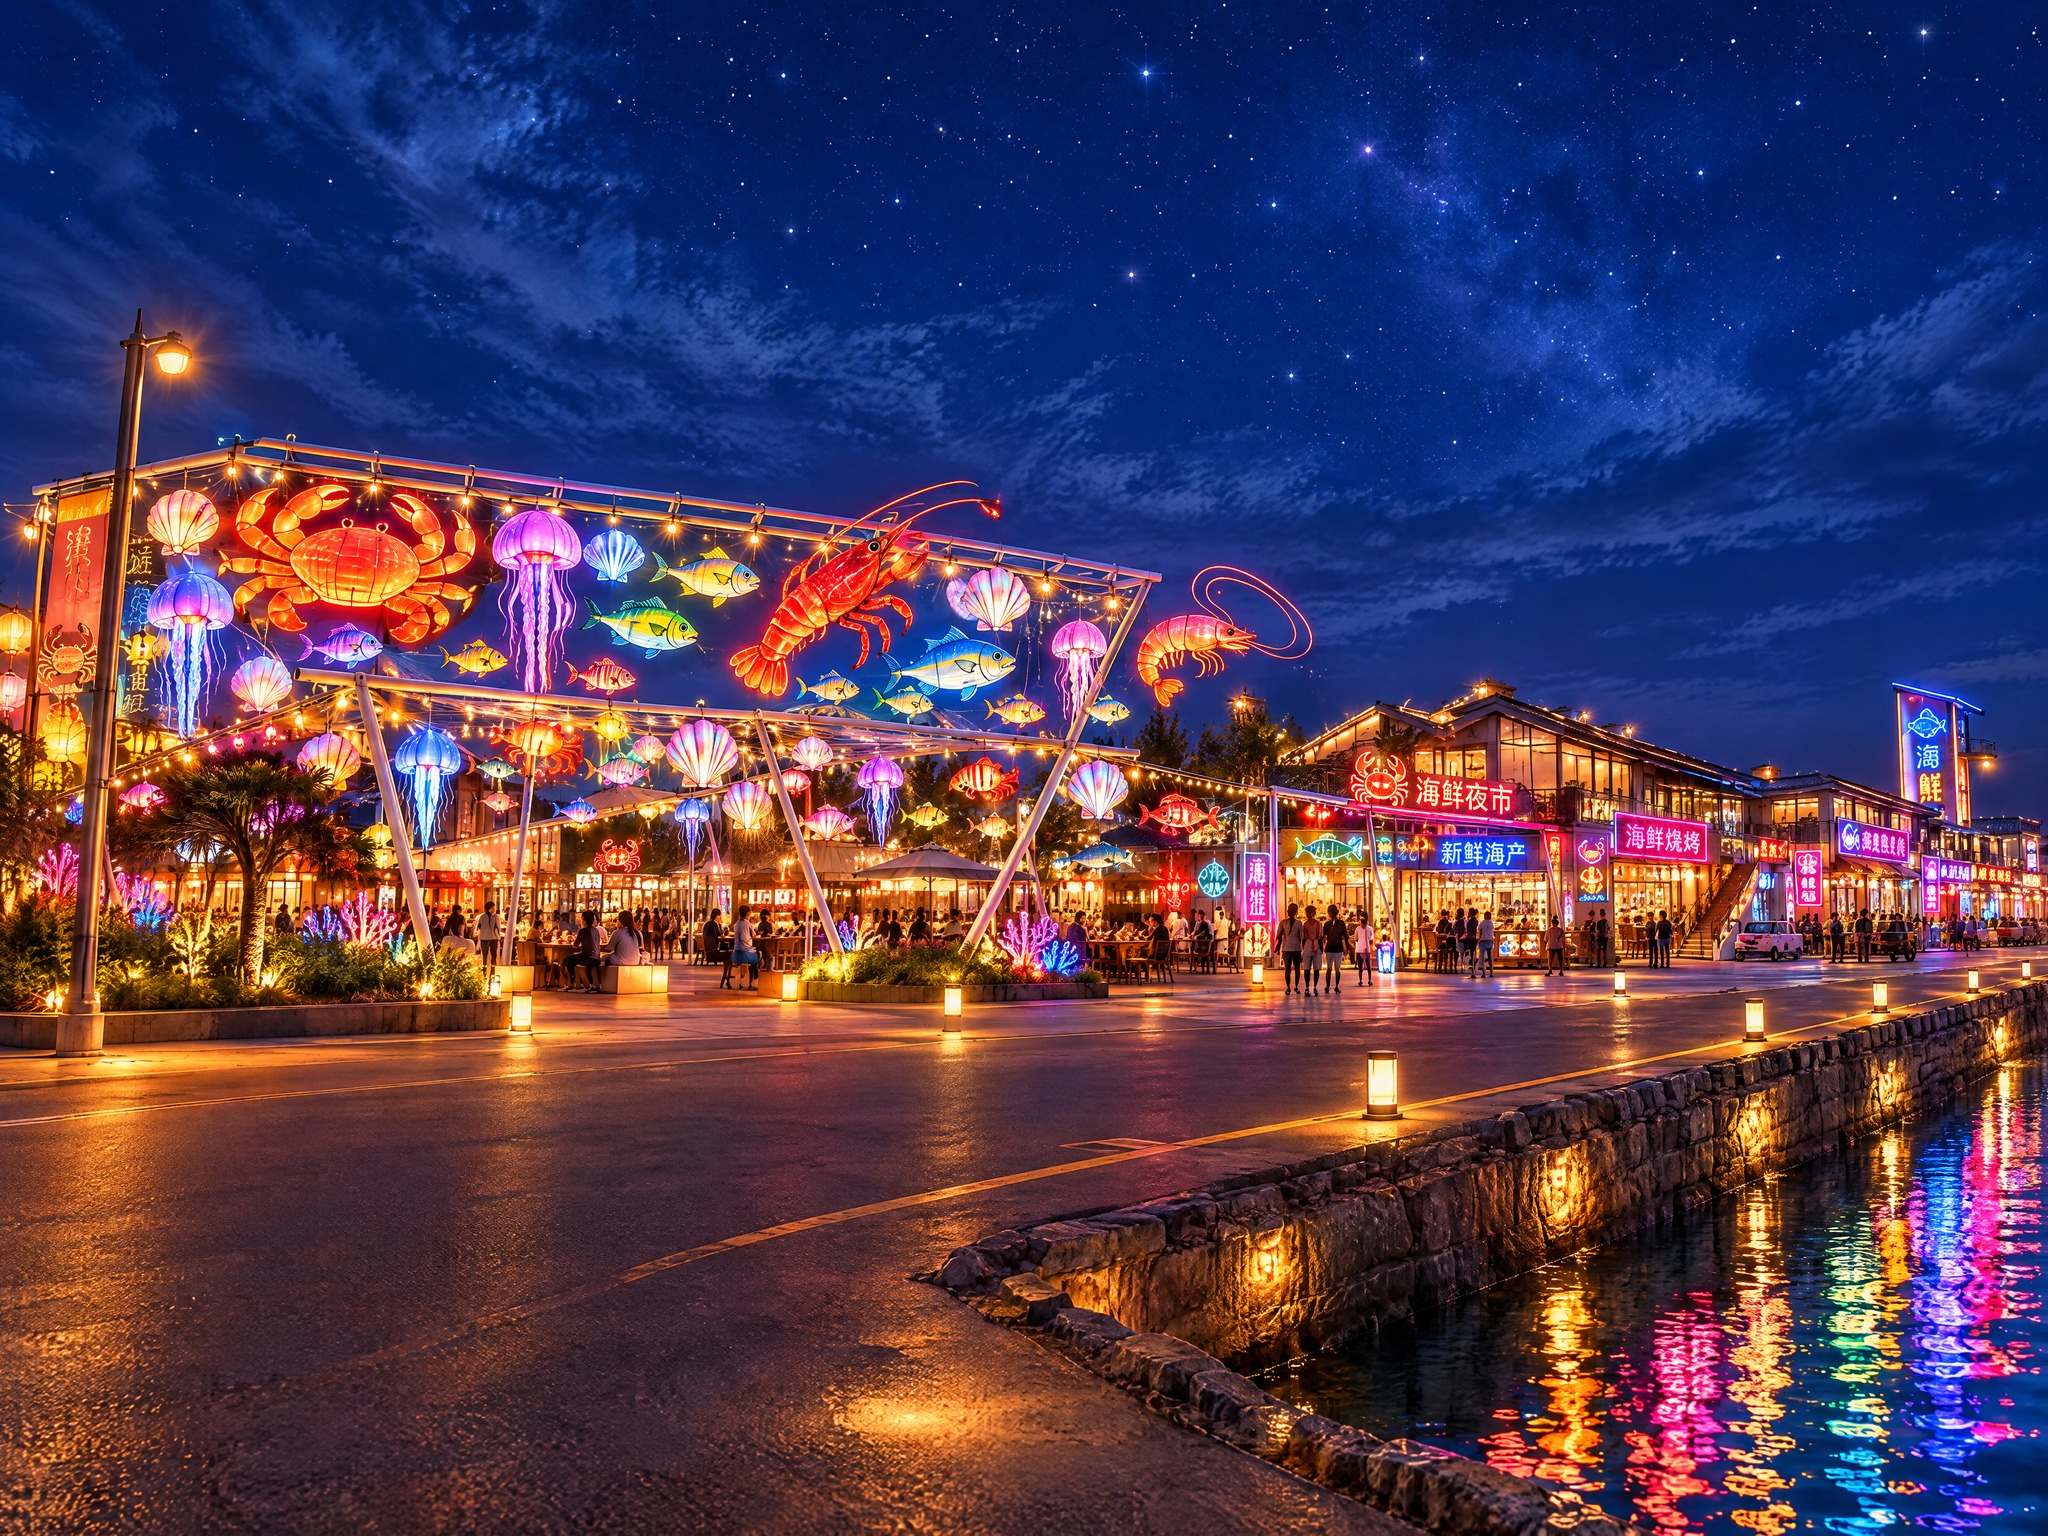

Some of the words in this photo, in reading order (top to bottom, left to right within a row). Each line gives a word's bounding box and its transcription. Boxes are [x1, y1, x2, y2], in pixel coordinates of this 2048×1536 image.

[1416, 776, 1513, 815] 海鲜夜市
[1441, 841, 1526, 867] 新鲜海产
